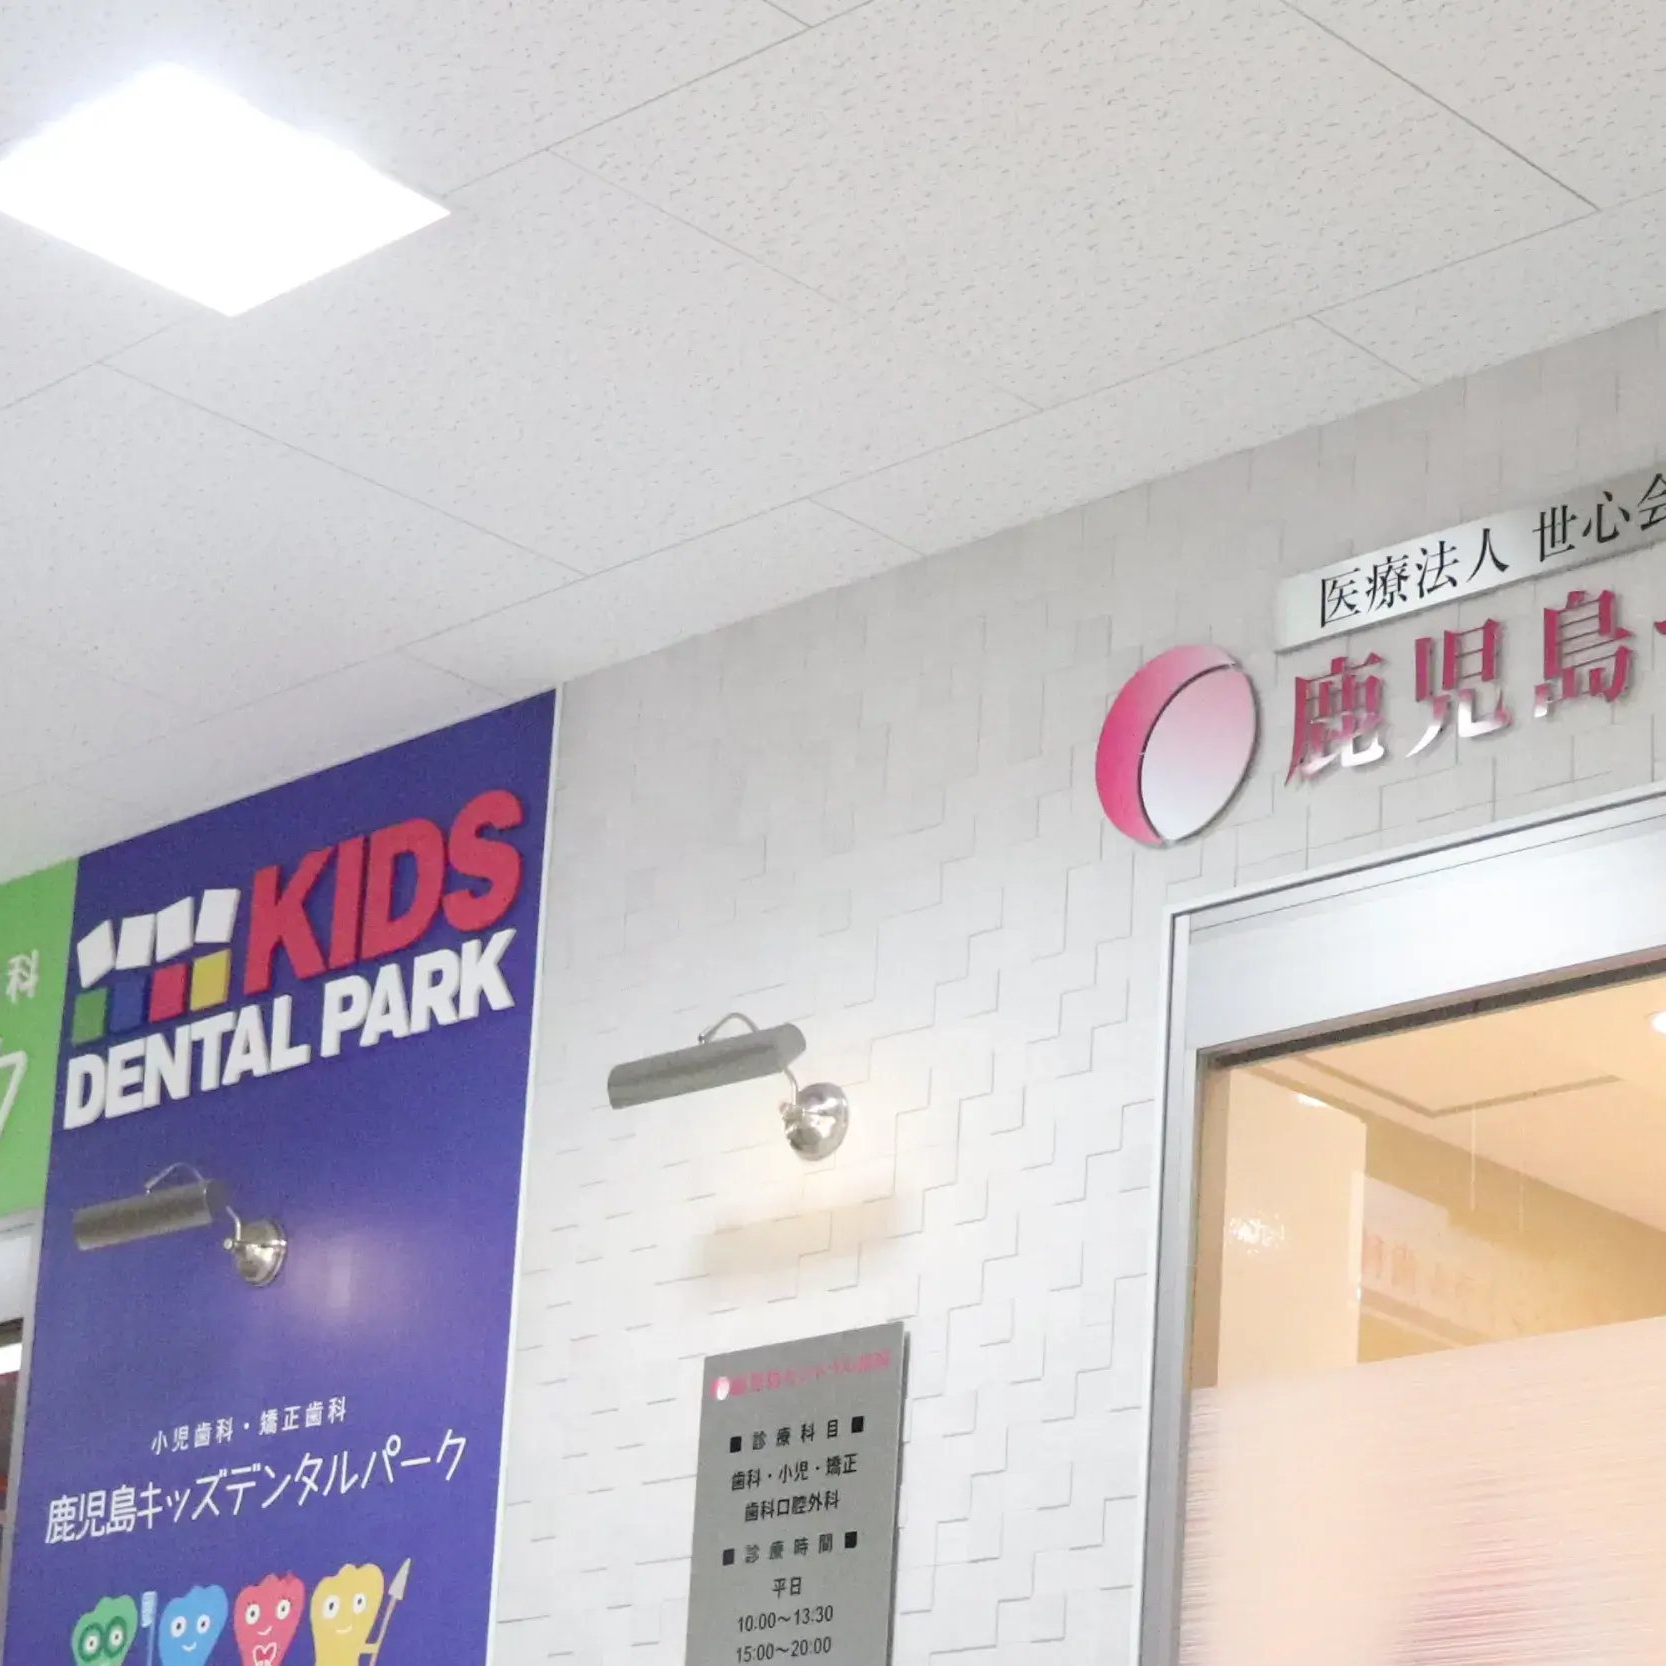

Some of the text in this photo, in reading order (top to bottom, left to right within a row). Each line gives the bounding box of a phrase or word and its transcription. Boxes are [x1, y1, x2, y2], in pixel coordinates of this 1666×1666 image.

[1320, 527, 1510, 629] 医療法人
[243, 789, 523, 996] KIDS
[63, 928, 517, 1130] DENTAL PARK
[151, 1396, 348, 1456] 小児歯科・矯正歯科
[45, 1428, 466, 1545] 鹿児島キッズデンタルパーク
[731, 1453, 858, 1491] 歯科・小児・矯正
[744, 1490, 840, 1522] 歯科口腔外科
[772, 1576, 802, 1599] 平日
